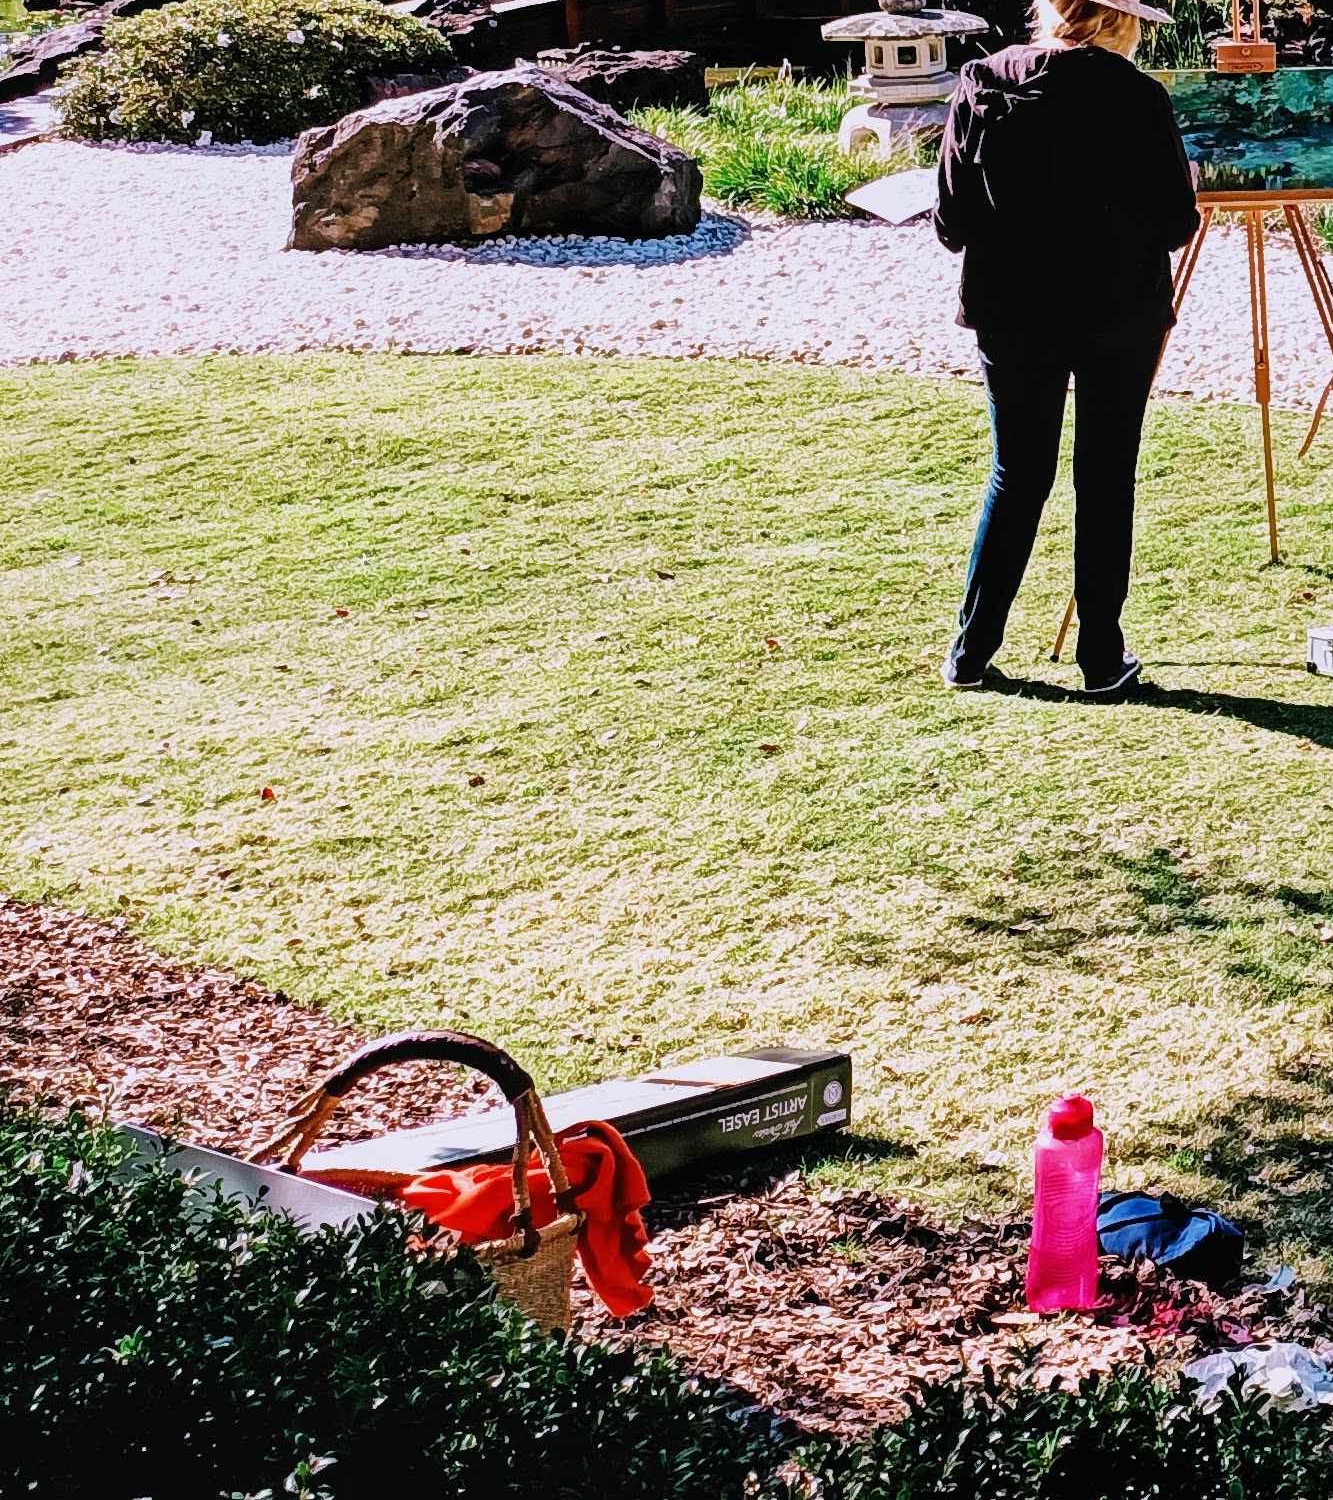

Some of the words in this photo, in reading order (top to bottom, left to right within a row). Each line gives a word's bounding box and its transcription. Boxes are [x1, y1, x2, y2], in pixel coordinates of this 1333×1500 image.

[763, 1094, 808, 1121] ARTIST
[718, 1108, 760, 1133] EASEL
[781, 1114, 804, 1135] Art
[752, 1123, 782, 1142] Series
